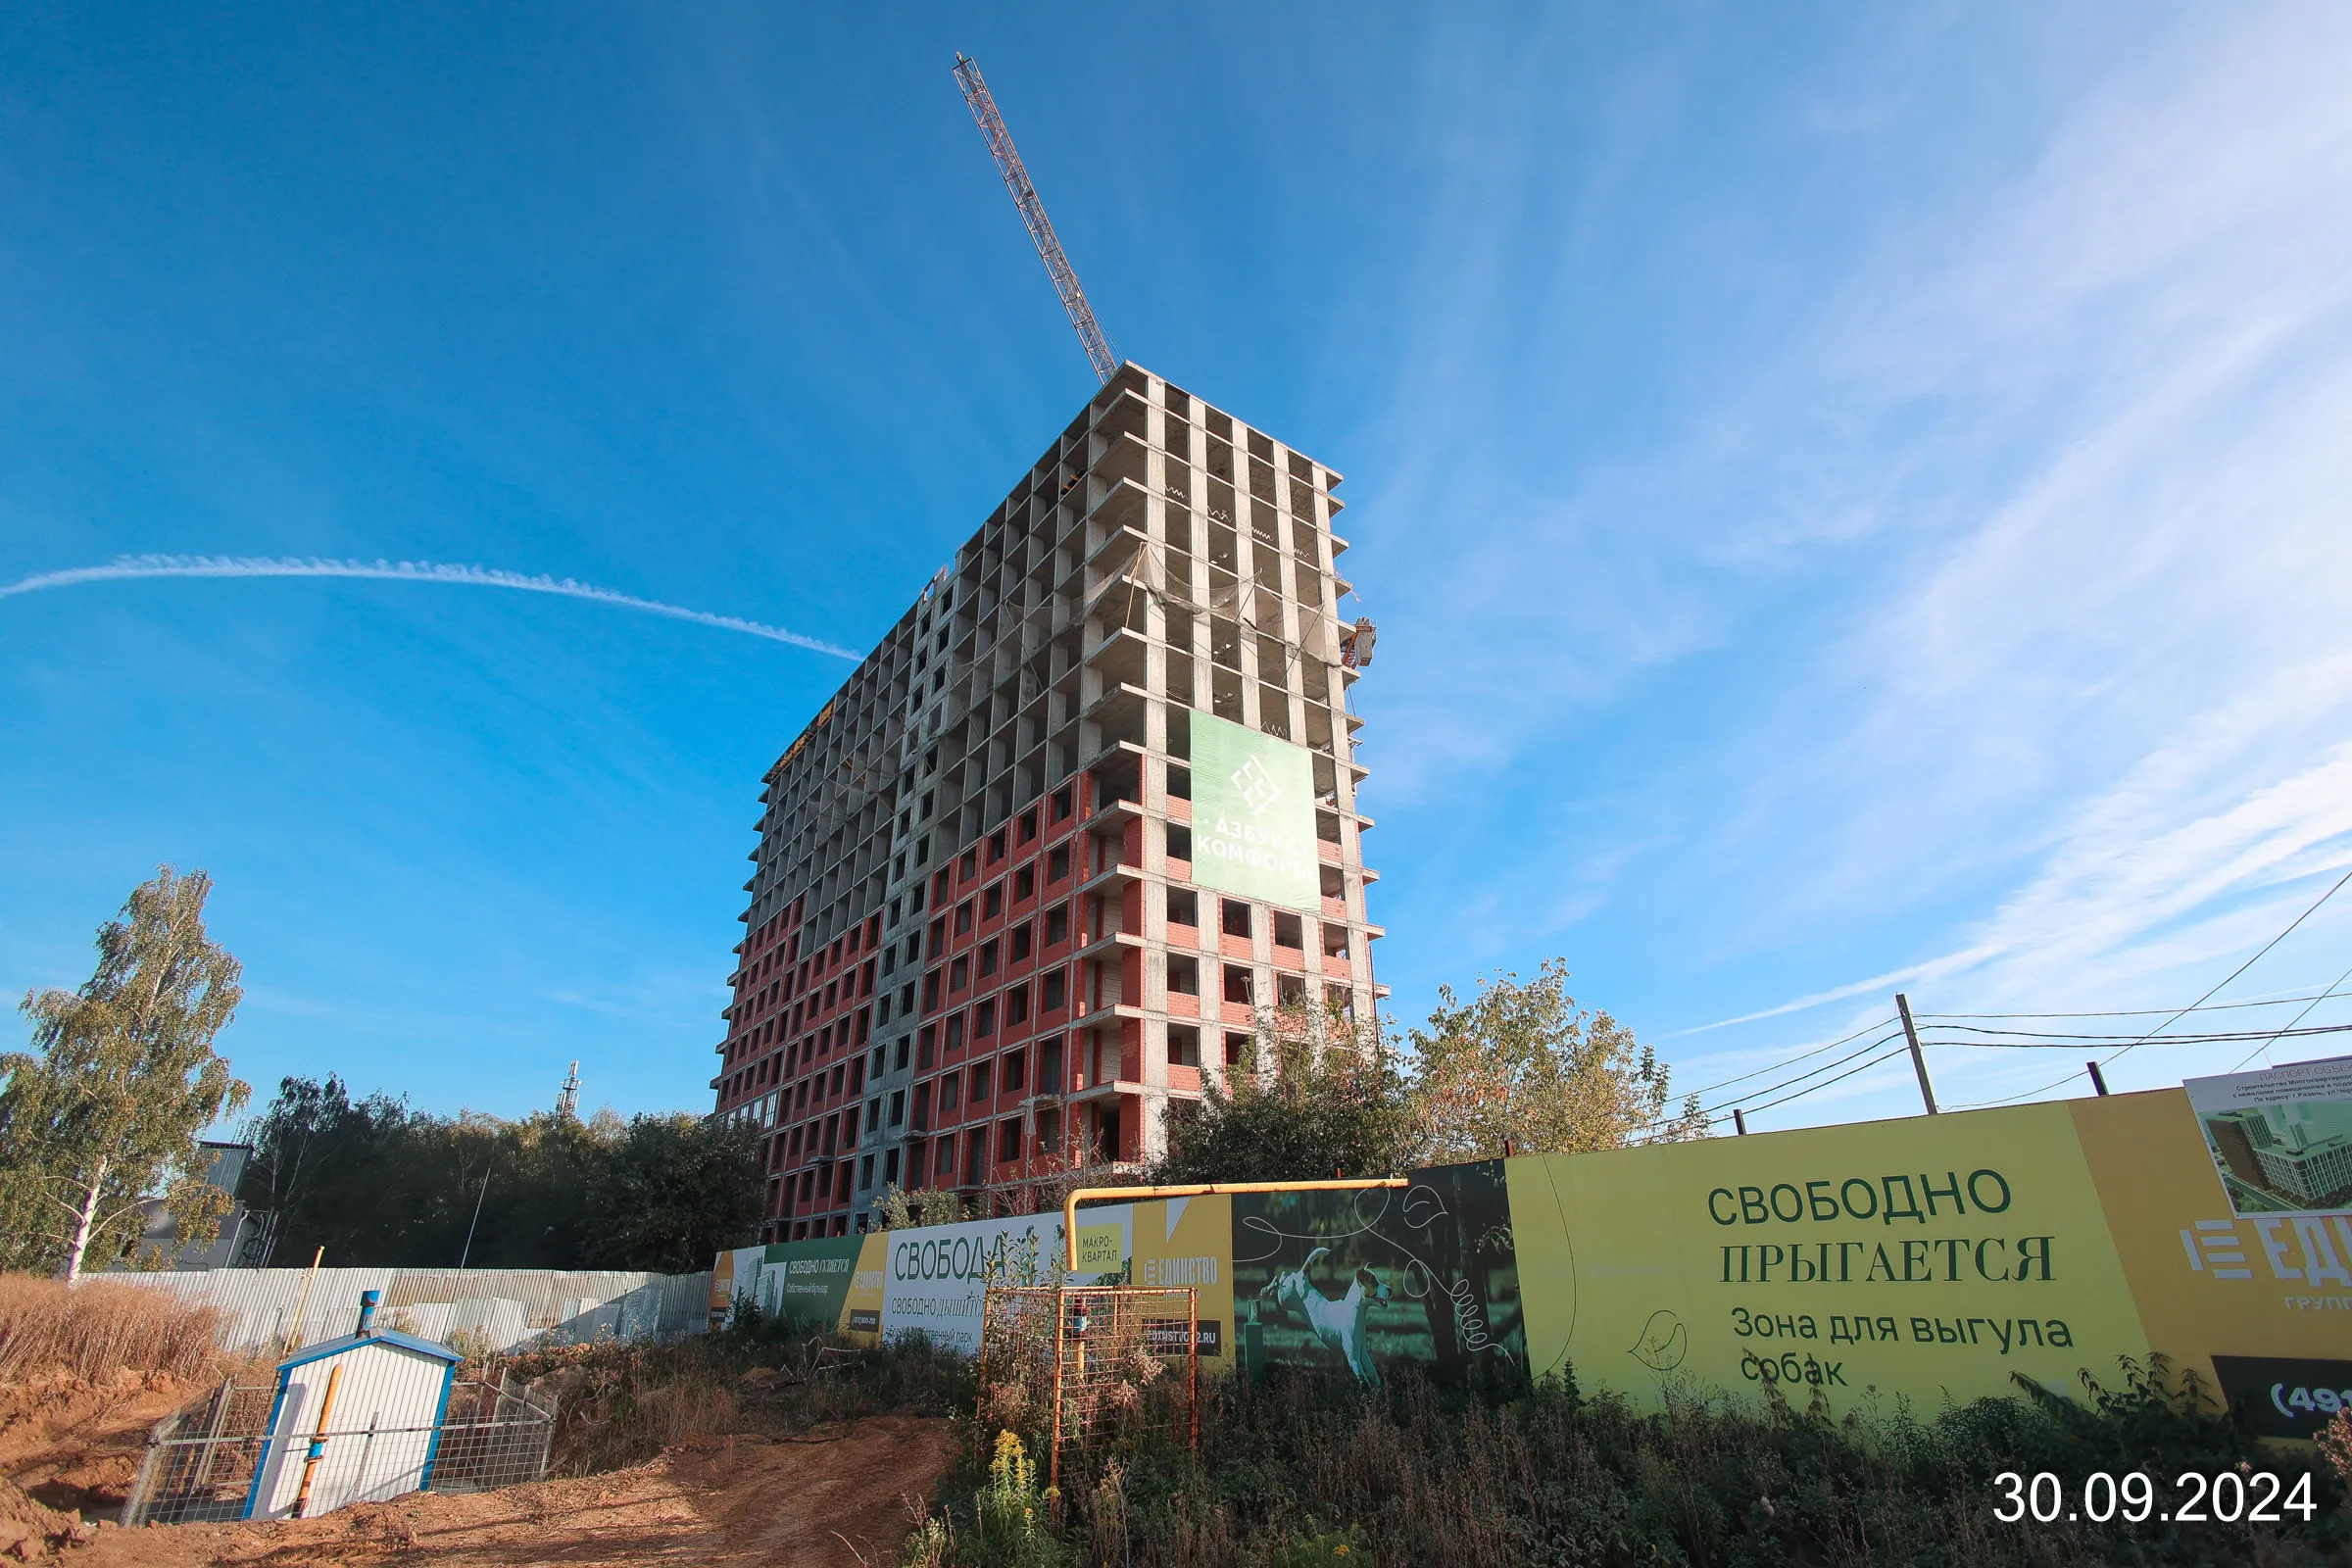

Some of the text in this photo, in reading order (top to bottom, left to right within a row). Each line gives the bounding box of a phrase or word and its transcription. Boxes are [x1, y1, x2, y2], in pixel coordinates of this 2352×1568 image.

[1215, 816, 1298, 855] АЗБУКА
[2259, 1068, 2311, 1081] ПАСПОРТ
[2235, 1081, 2286, 1093] Строительство
[2276, 1084, 2326, 1095] помещениями
[1707, 1168, 2011, 1226] СВОБОДНО
[1082, 1235, 1113, 1249] МАКРО-
[895, 1234, 1005, 1285] СВОБОДА
[1082, 1250, 1117, 1263] КВАРТАЛ
[1719, 1236, 2057, 1283] ПРЫГАЕТСЯ
[789, 1259, 819, 1275] СВОБОДНО
[1158, 1255, 1218, 1287] ЕДИНСТВО
[891, 1298, 985, 1320] СВОБОДНО ДЫШИТС
[956, 1331, 973, 1346] парк
[1148, 1329, 1216, 1344] EDINSTVO2.RU
[1731, 1306, 2074, 1355] Зона для выгула
[1740, 1351, 1849, 1387] собак
